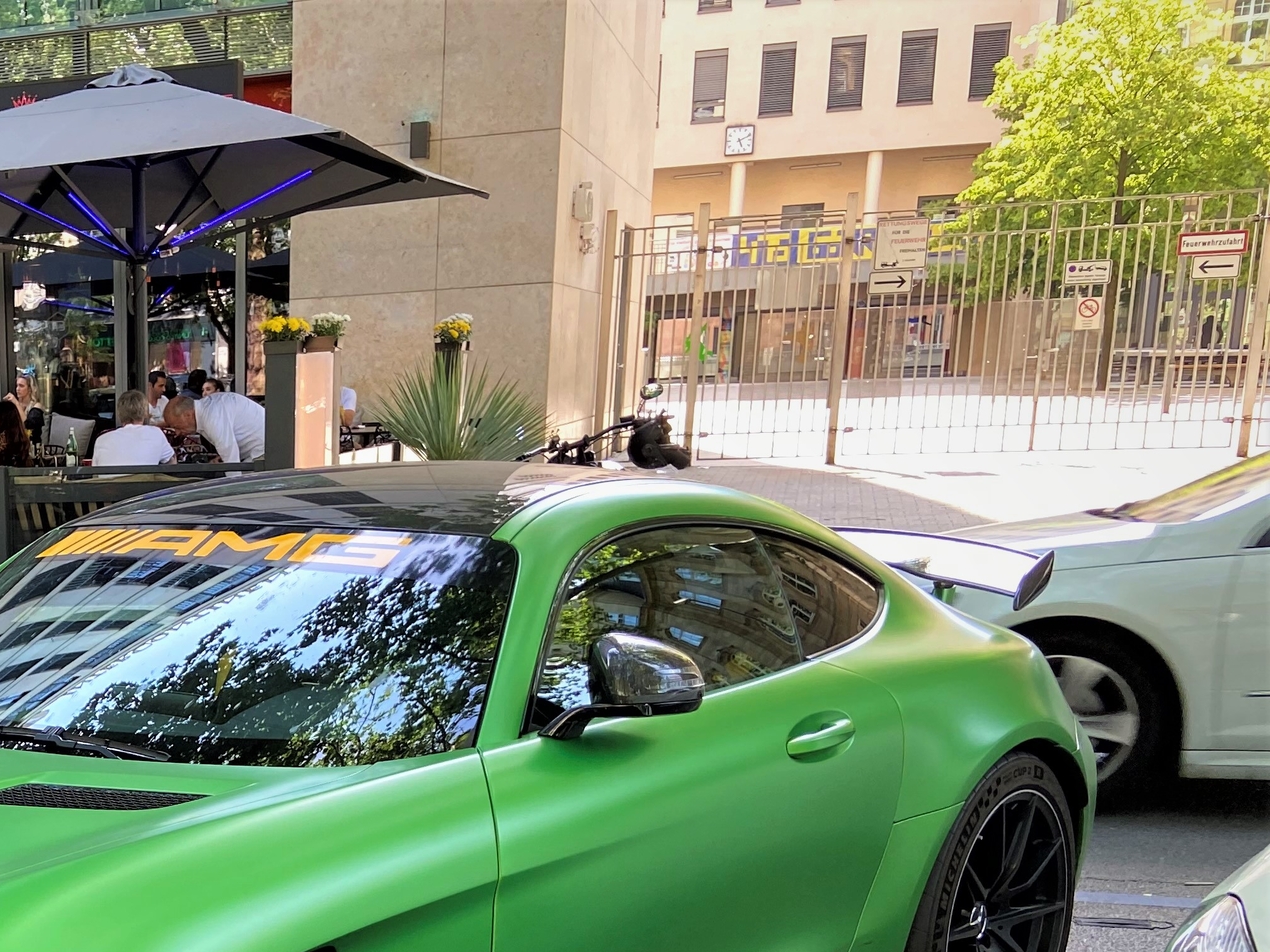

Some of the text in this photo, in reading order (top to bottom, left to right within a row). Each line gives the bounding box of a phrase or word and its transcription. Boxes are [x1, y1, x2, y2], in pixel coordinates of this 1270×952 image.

[890, 237, 926, 245] FEUERWEHR
[1182, 237, 1244, 249] Feuerwehrzufahrt
[937, 805, 980, 916] MICHELIN
